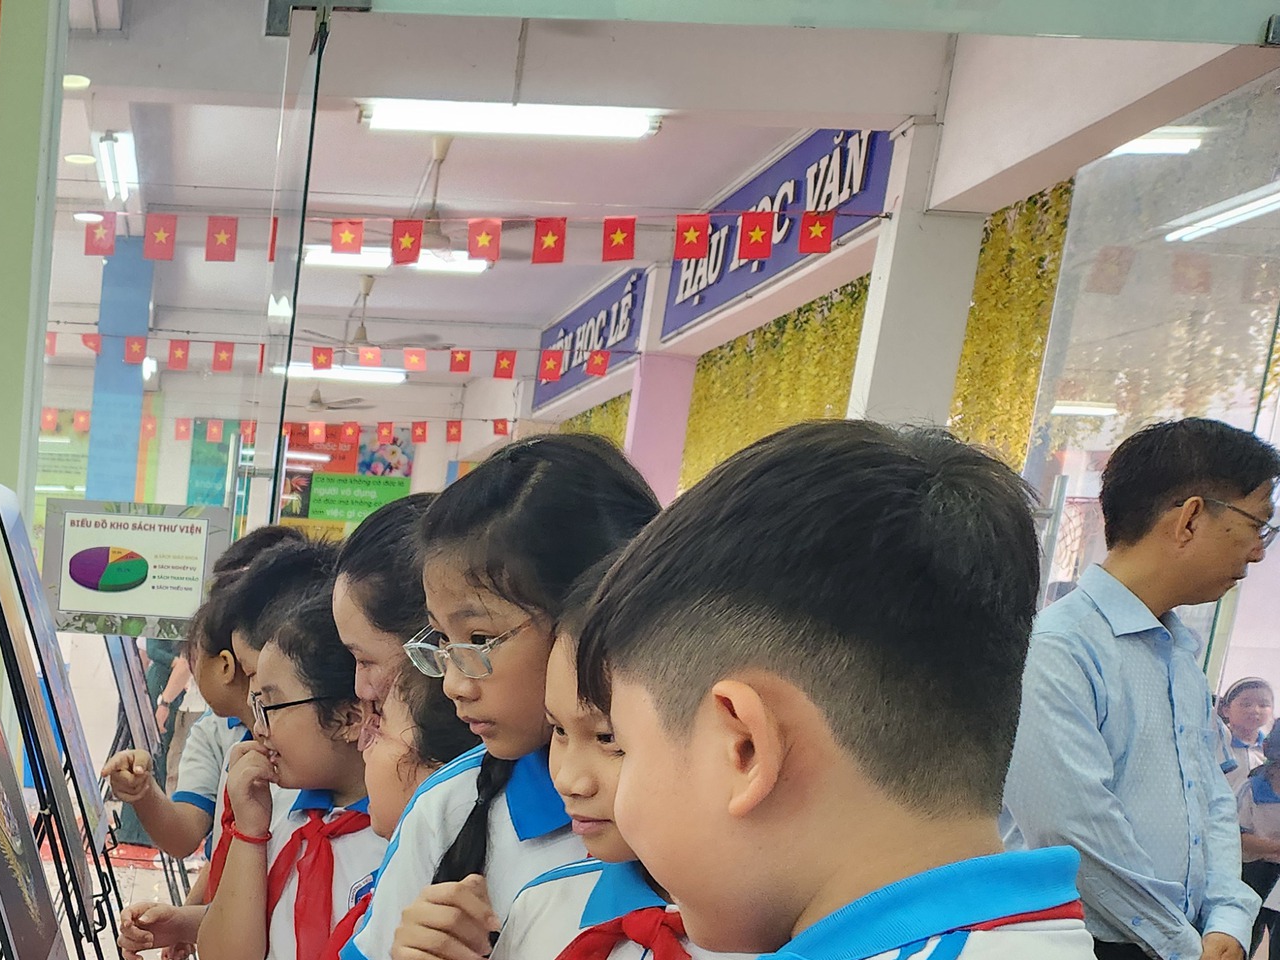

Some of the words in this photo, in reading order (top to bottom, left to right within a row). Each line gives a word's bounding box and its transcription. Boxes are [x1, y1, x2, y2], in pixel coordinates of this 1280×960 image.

[806, 129, 873, 212] VĂN
[94, 518, 108, 529] ĐỒ
[109, 522, 130, 530] KHO
[131, 520, 156, 532] SÁCH
[158, 523, 178, 533] THƯ
[179, 522, 203, 535] VIỆN
